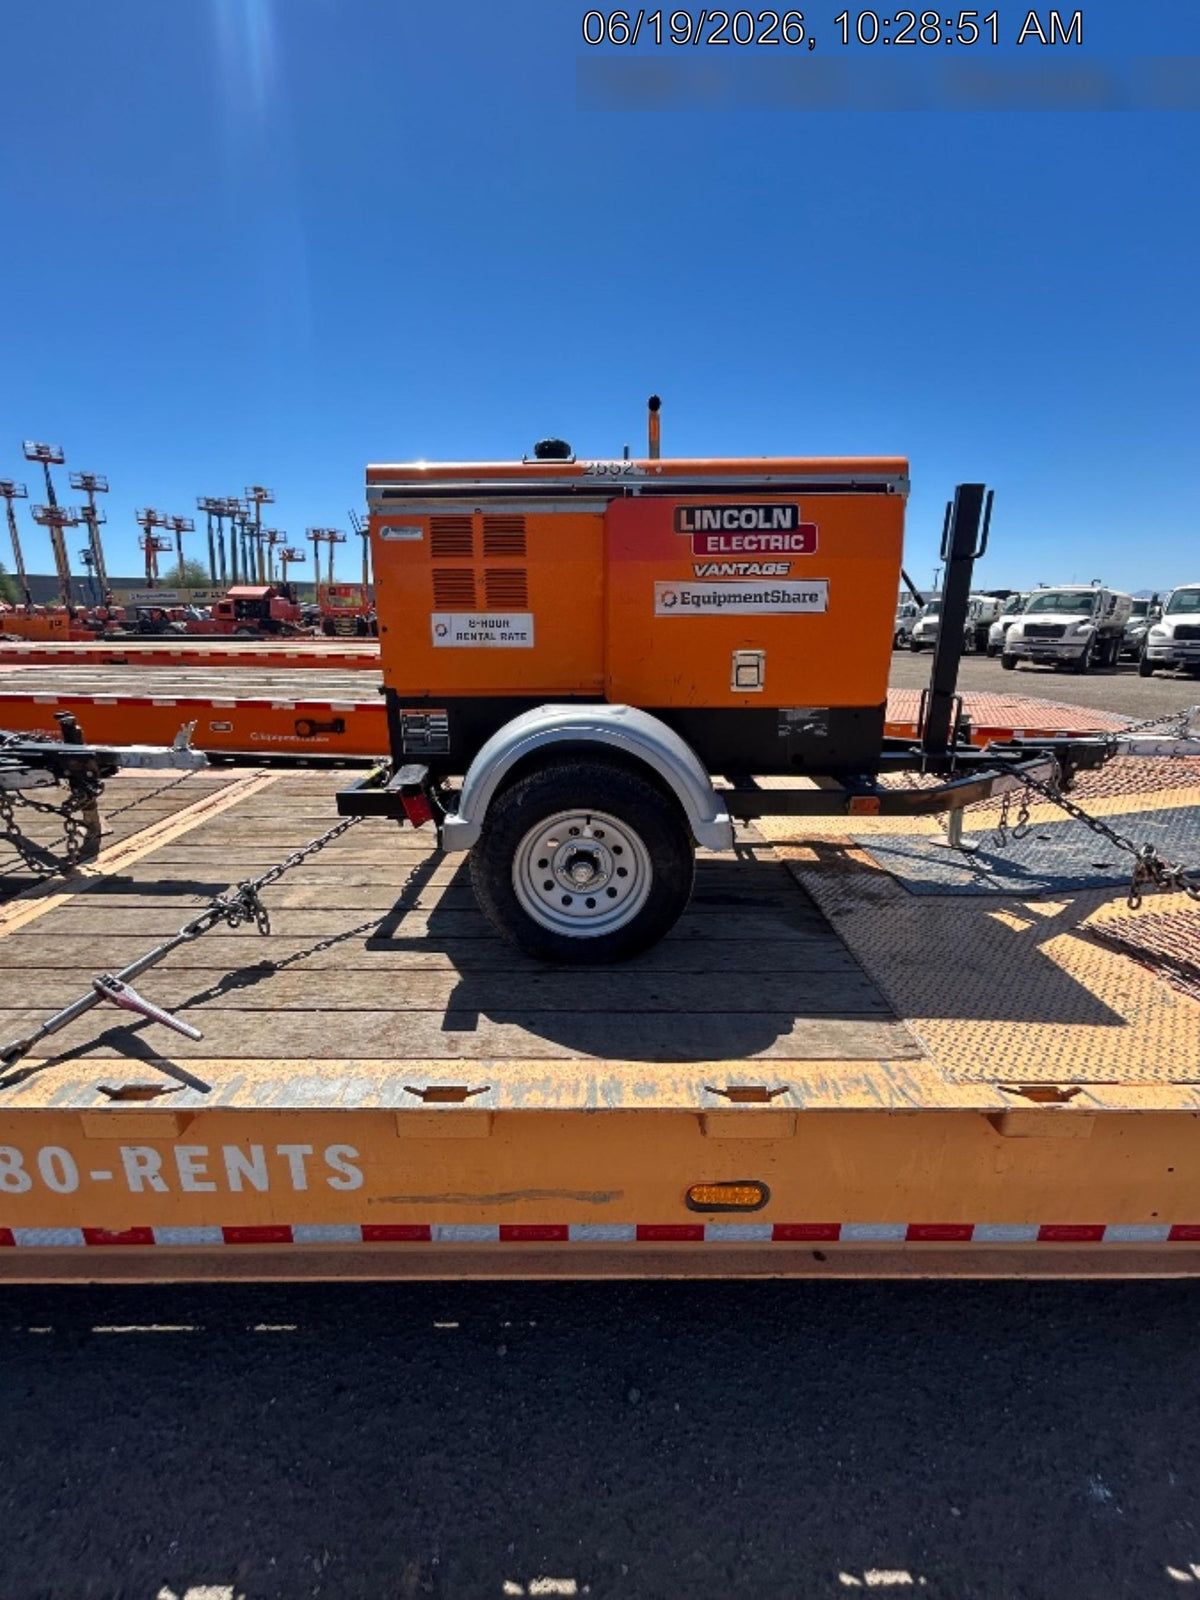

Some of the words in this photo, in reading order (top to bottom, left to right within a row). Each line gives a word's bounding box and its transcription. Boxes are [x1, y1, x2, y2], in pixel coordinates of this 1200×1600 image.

[680, 508, 792, 530] LINCOLN
[707, 535, 804, 551] ELECTRIC
[693, 562, 792, 577] VANTAGE
[680, 590, 819, 606] EquipmentShare
[456, 632, 496, 641] RENTAL
[500, 632, 527, 641] RATE
[0, 1144, 364, 1194] 80-RENTS
